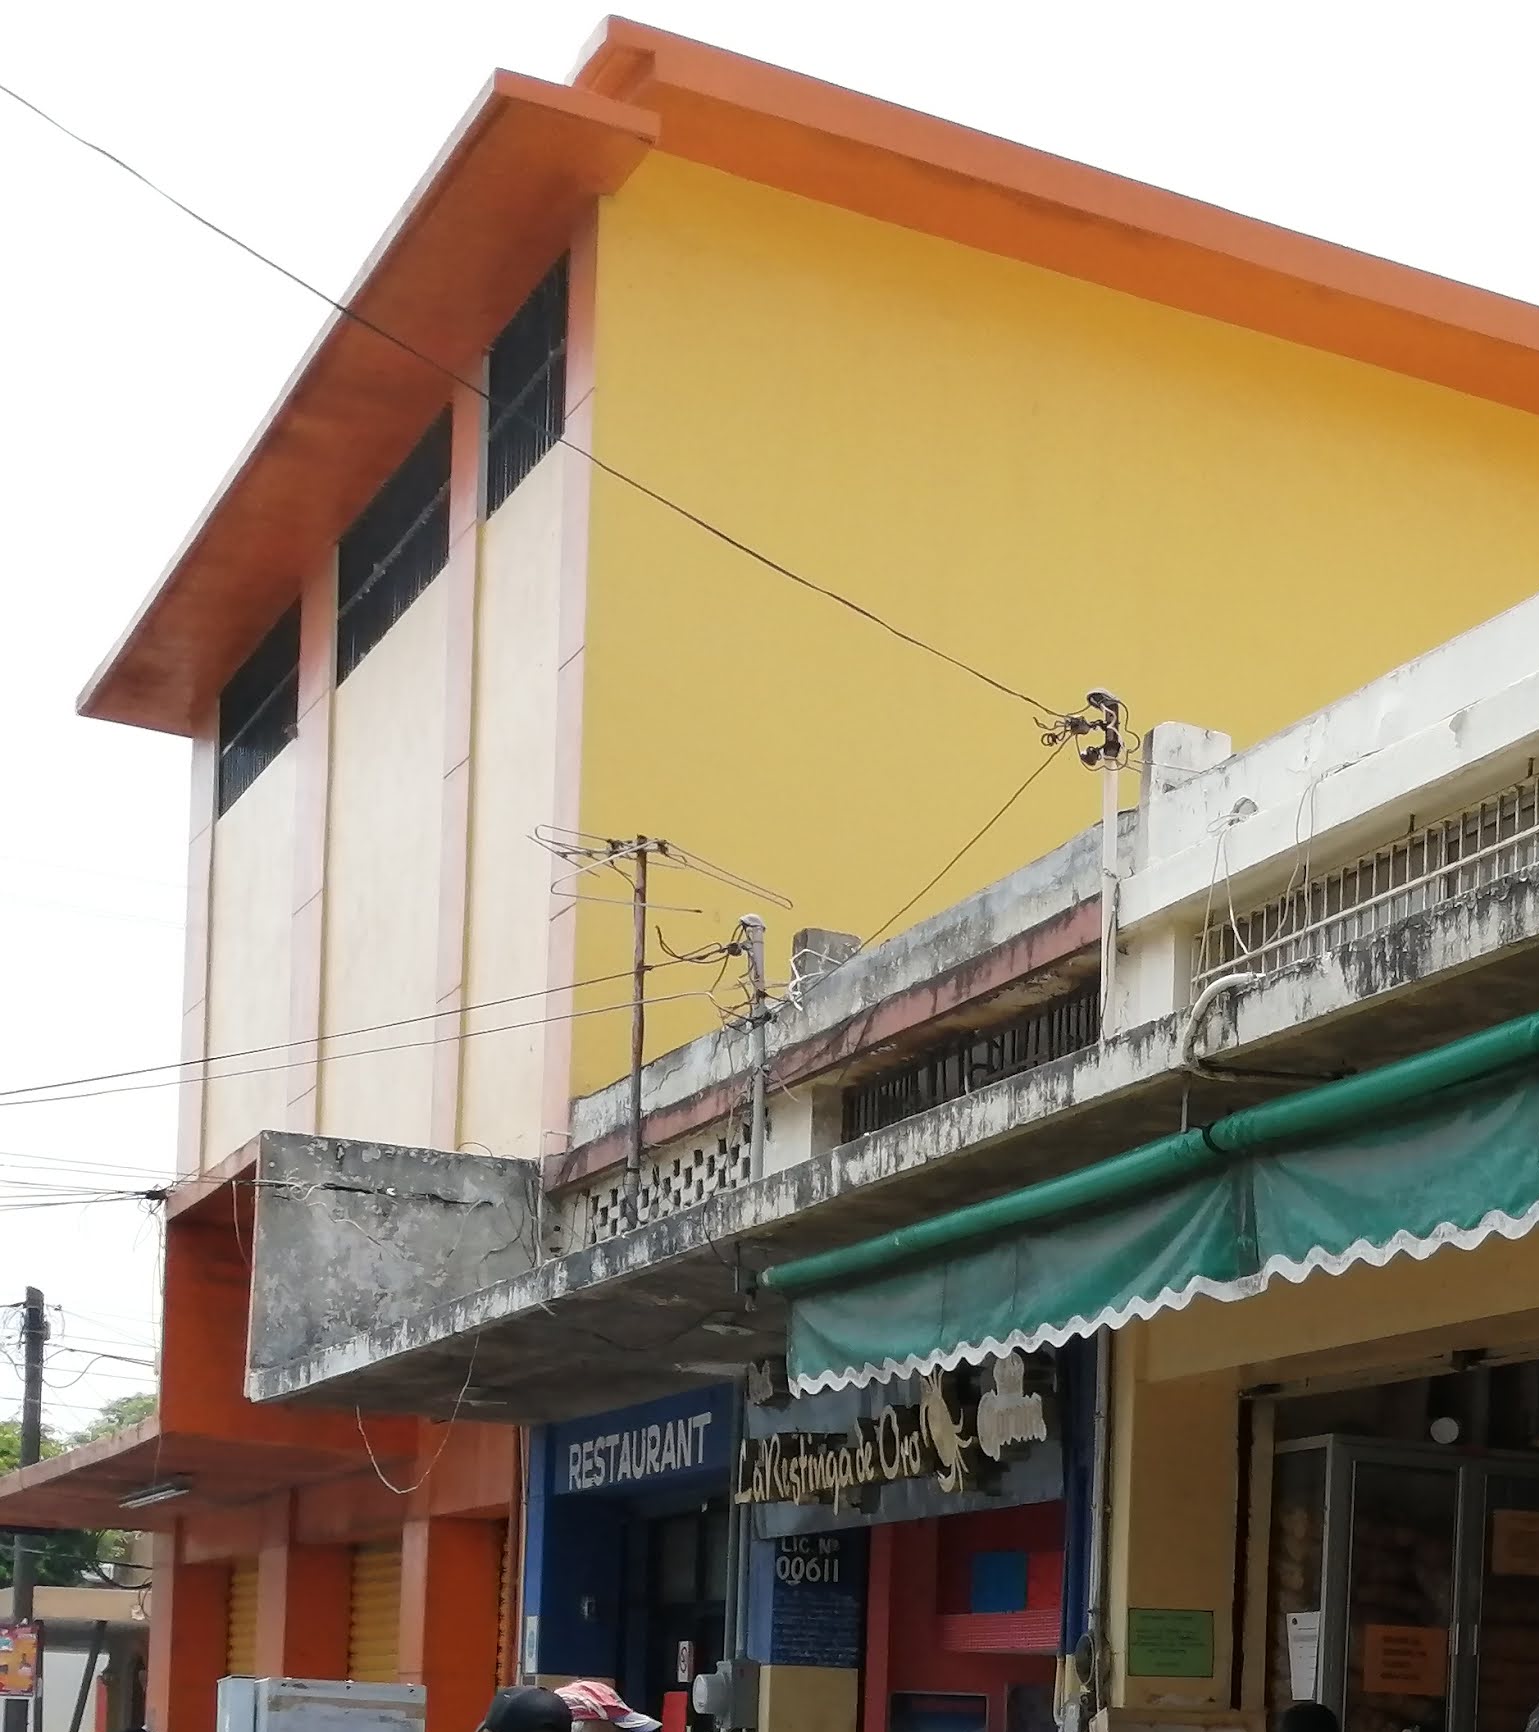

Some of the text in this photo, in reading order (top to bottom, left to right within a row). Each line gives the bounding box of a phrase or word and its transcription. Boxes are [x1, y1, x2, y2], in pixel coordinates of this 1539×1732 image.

[568, 1411, 713, 1491] RESTAURANT
[734, 1437, 764, 1505] La
[850, 1416, 876, 1483] de
[874, 1403, 921, 1480] Oro
[775, 1554, 840, 1585] 00611
